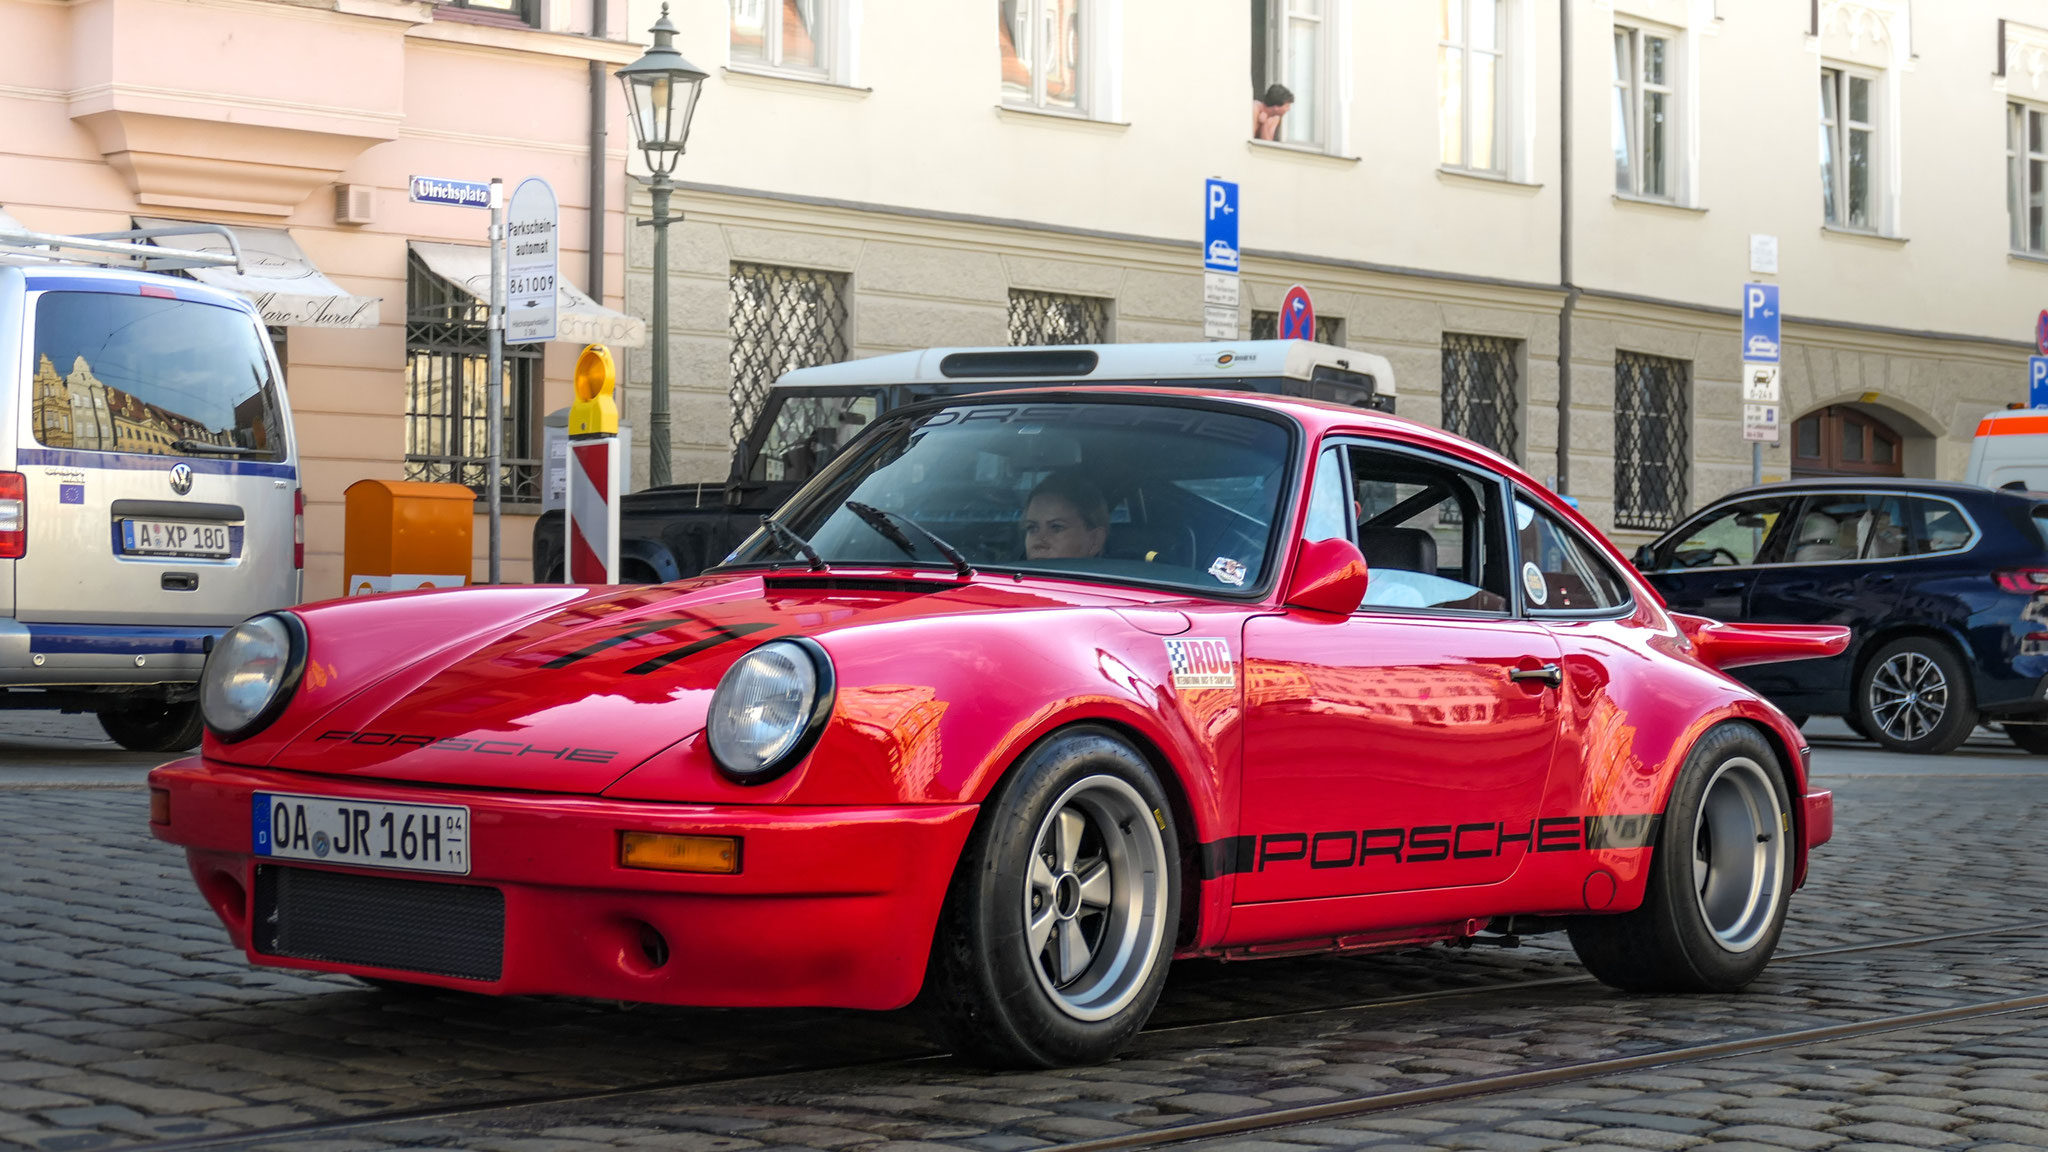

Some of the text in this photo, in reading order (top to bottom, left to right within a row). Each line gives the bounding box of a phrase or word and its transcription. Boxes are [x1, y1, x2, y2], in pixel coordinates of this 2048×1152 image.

[419, 180, 487, 204] Ulrichsplatz
[1209, 184, 1227, 220] P
[508, 218, 557, 237] Parkschein-
[516, 240, 549, 256] automat
[510, 275, 554, 294] 861009
[295, 295, 370, 325] Aurel
[1749, 288, 1765, 319] P
[2033, 361, 2047, 389] P
[140, 524, 152, 547] A
[164, 525, 188, 549] XP
[193, 529, 225, 549] 180
[1182, 641, 1231, 674] IROC
[315, 730, 618, 764] PORSCHE
[273, 802, 309, 850] OA
[333, 808, 370, 856] JR
[380, 812, 441, 862] 16H
[1258, 815, 1581, 872] PORSCHE
